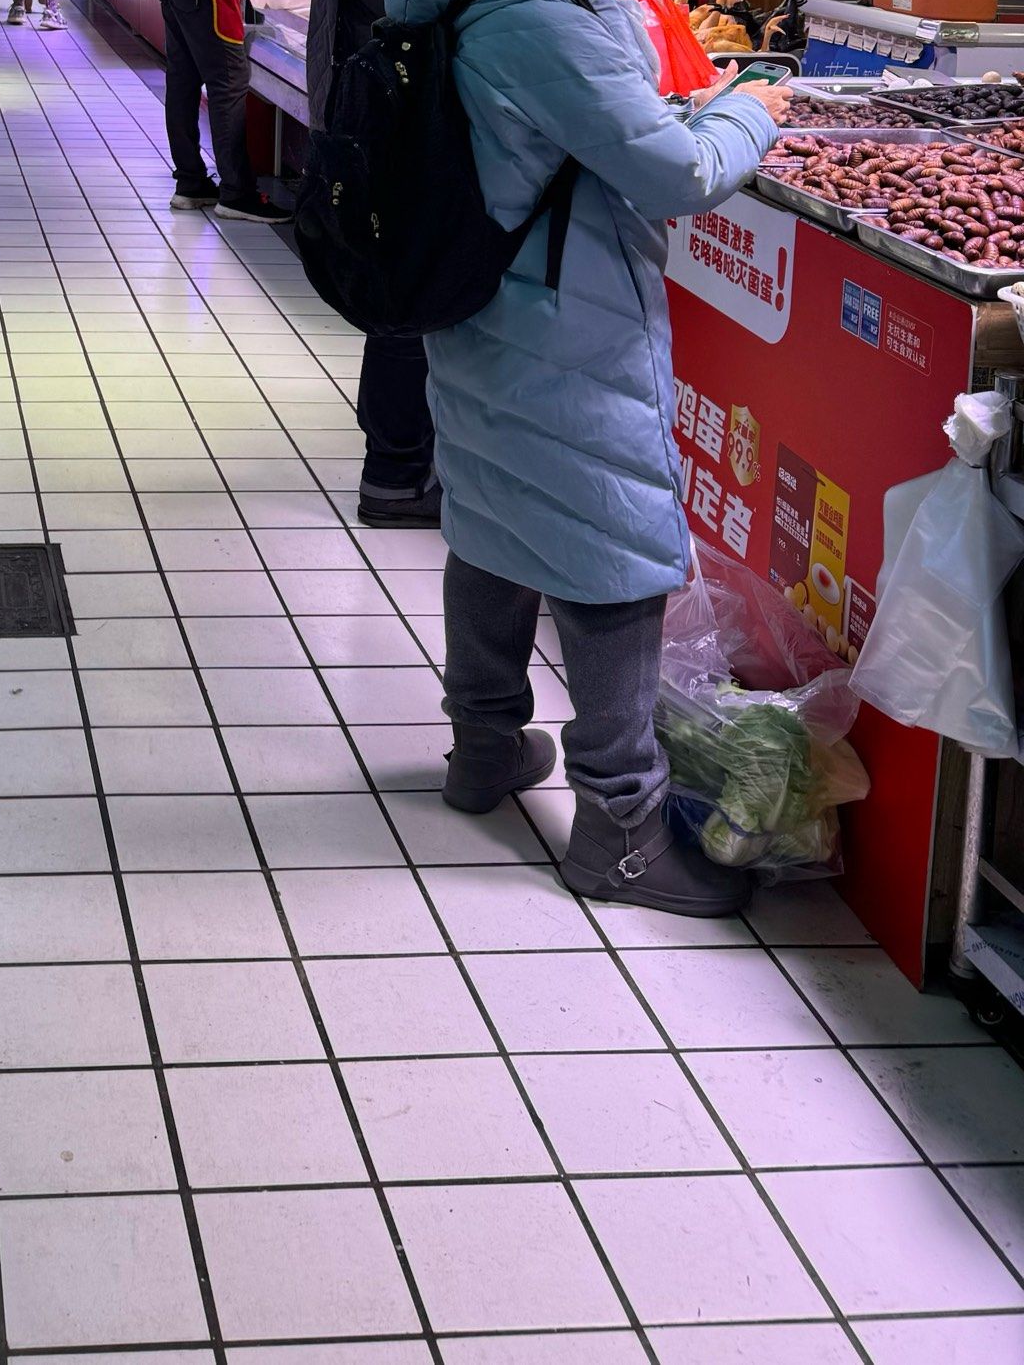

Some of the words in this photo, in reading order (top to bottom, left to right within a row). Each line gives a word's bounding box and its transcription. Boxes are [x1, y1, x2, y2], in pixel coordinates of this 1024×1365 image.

[887, 322, 921, 349] 无抗生素和
[886, 336, 926, 369] 可生食双认证
